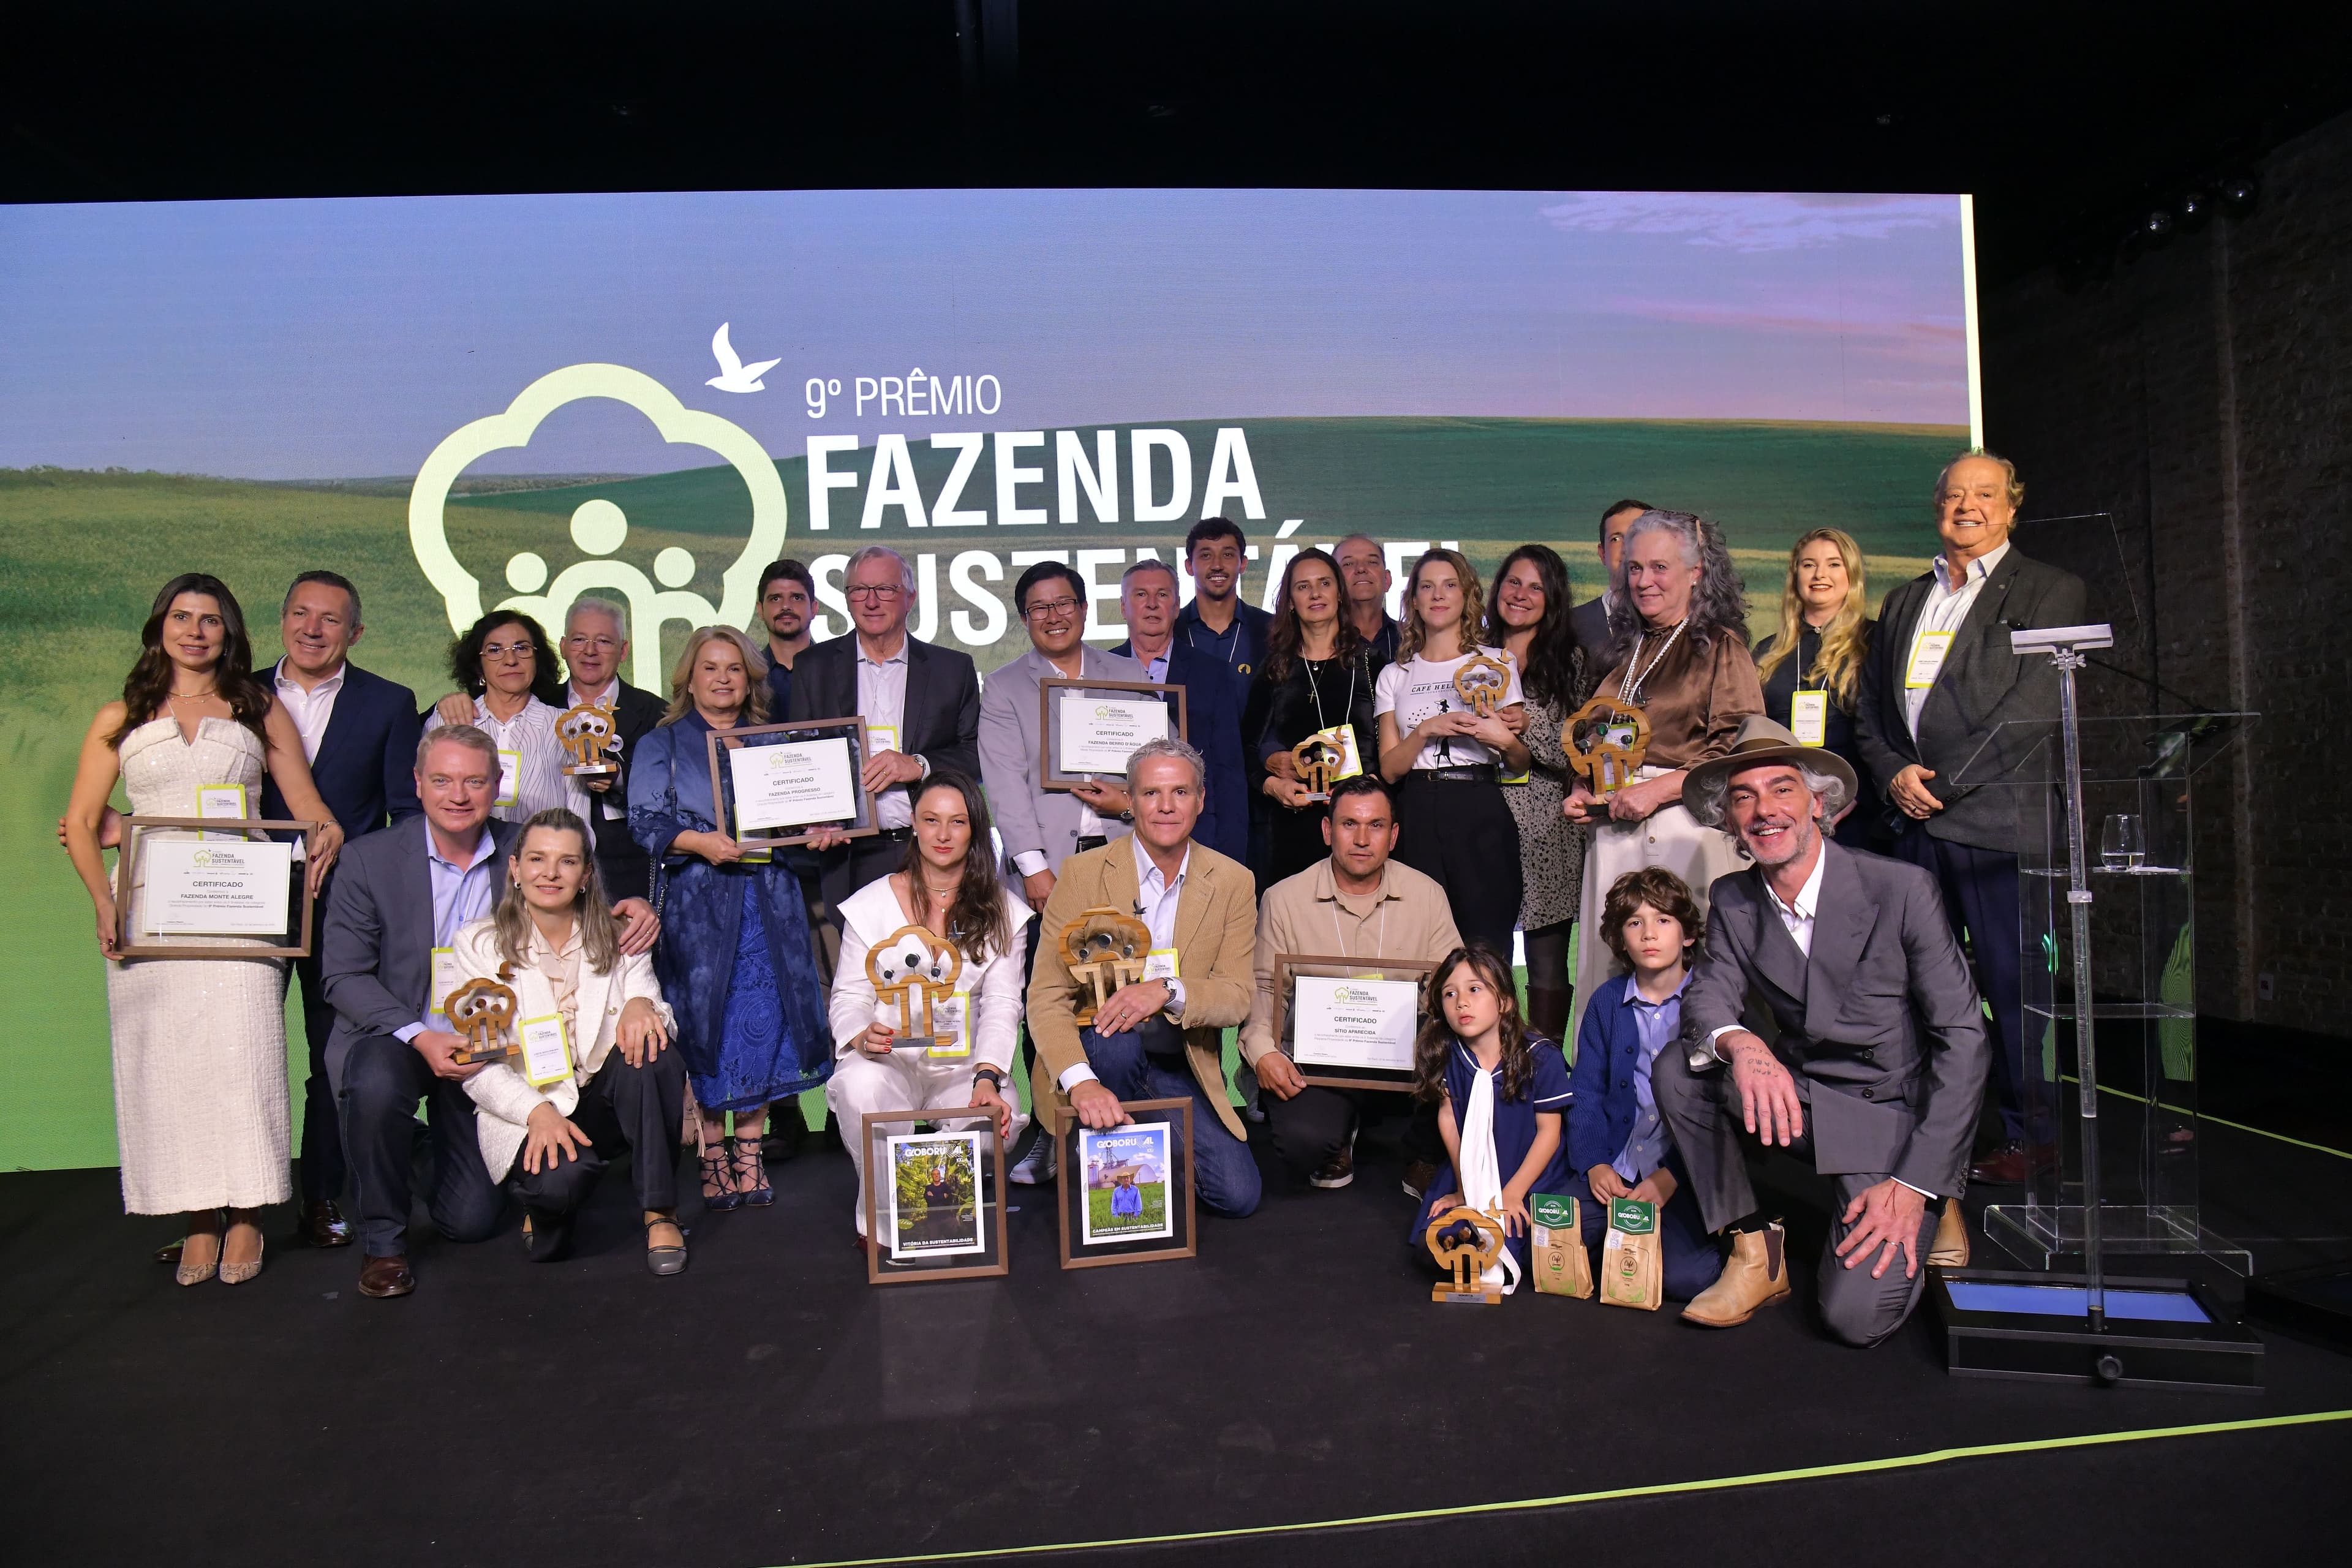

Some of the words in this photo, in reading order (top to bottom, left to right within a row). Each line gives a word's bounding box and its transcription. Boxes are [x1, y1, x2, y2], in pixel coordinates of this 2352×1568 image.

[805, 377, 842, 419] 9º
[855, 366, 1002, 417] PRÊMIO
[806, 427, 1267, 530] FAZENDA
[1411, 684, 1432, 693] CAFÉ
[772, 776, 814, 786] CERTIFICADO
